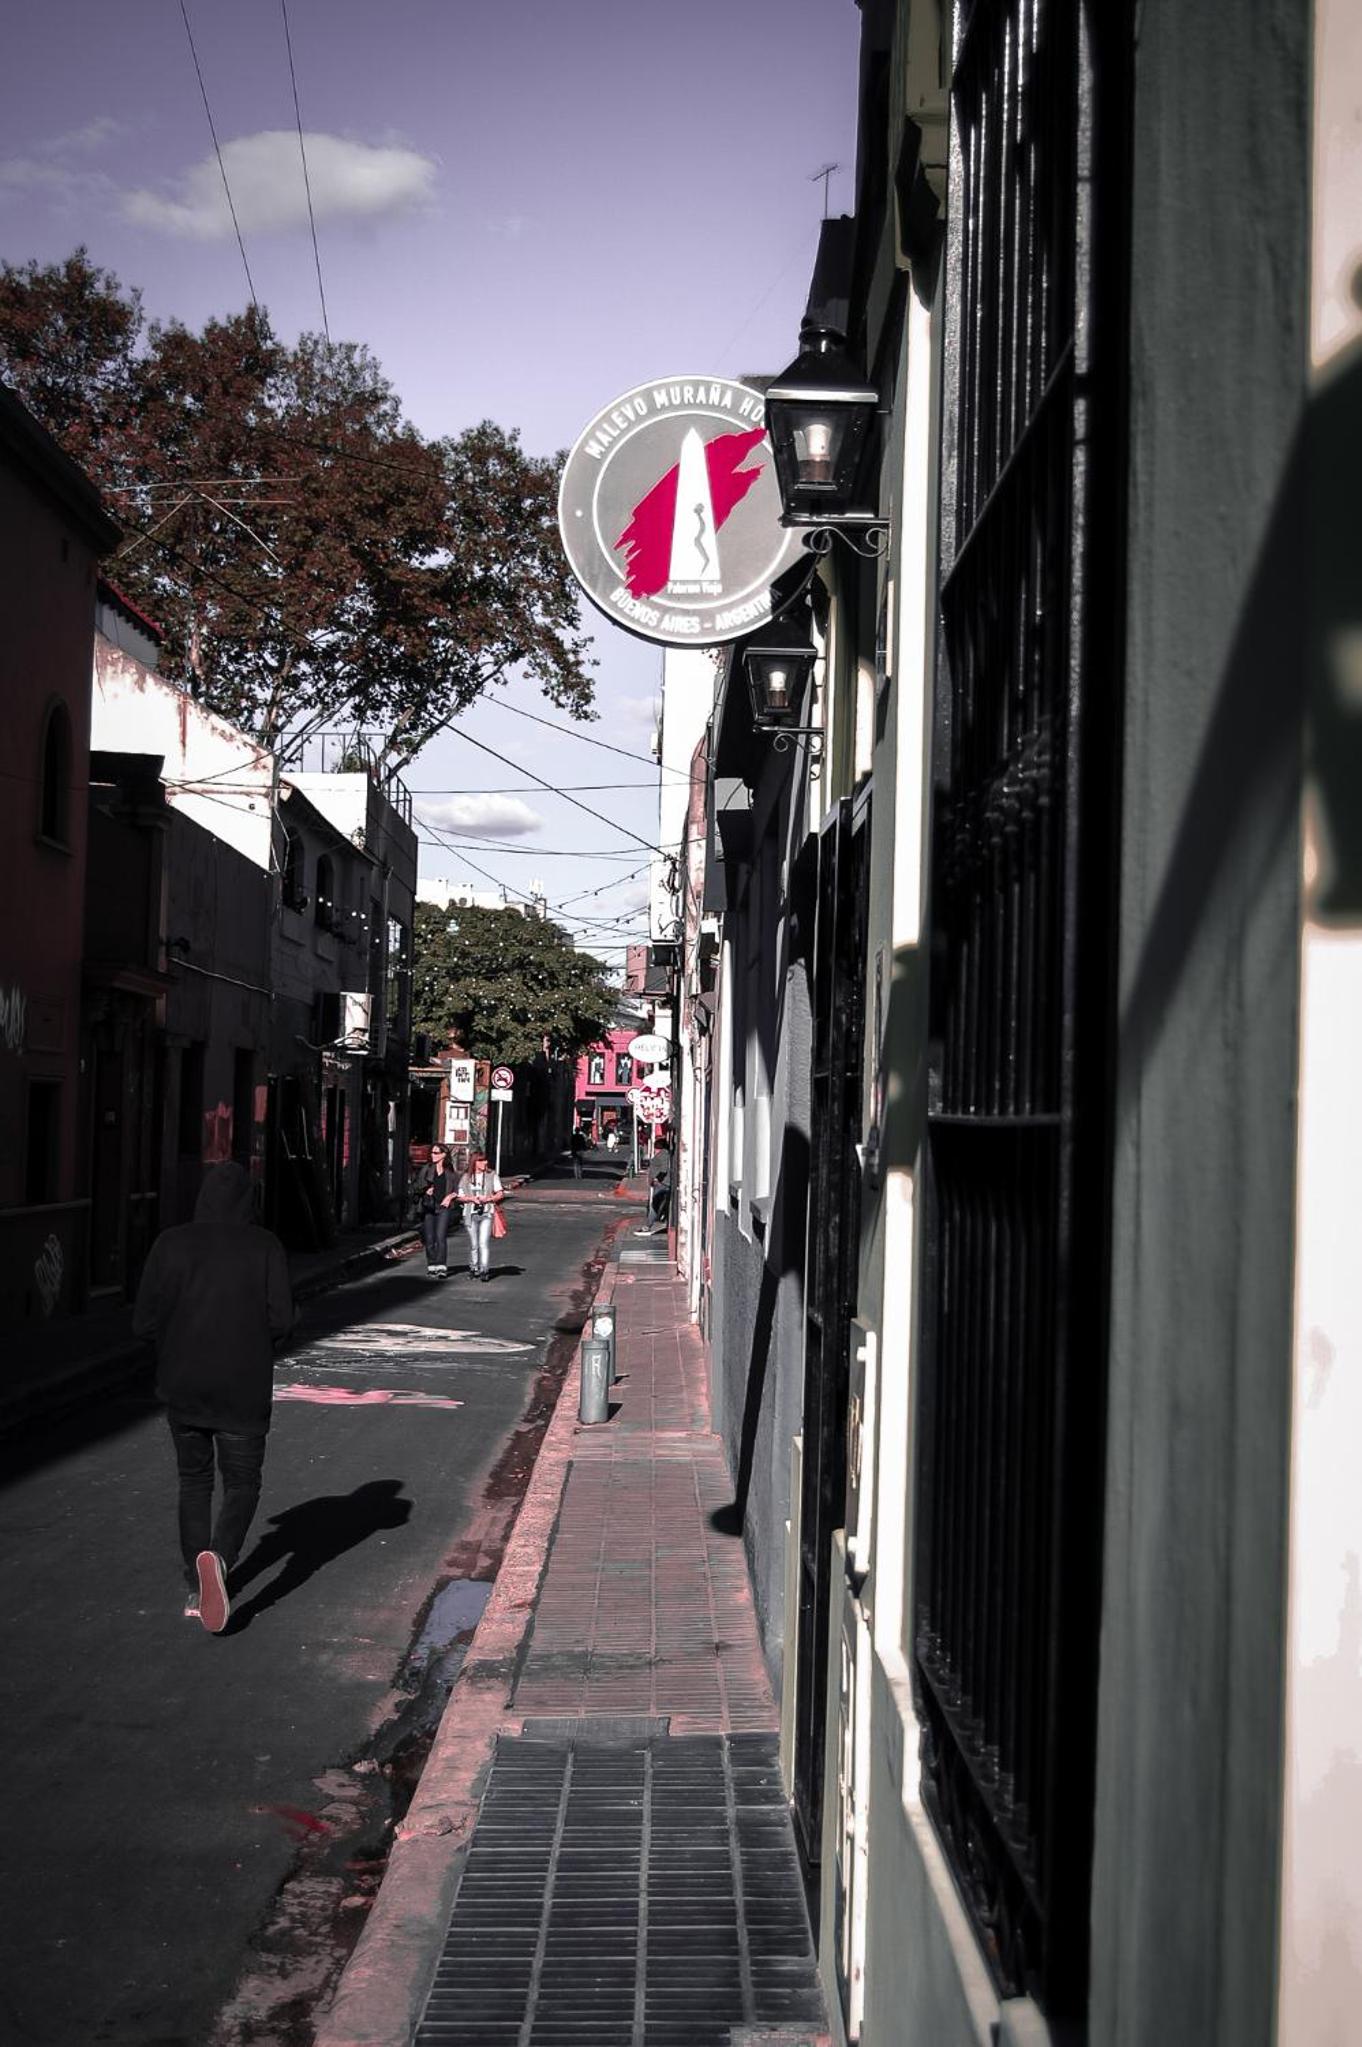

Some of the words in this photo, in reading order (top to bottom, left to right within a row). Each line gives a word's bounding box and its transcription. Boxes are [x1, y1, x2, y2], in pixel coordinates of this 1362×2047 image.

[584, 399, 650, 460] MALEVO
[653, 383, 732, 409] MURAÑA
[738, 398, 765, 428] HO
[609, 586, 660, 627] BUENOS
[661, 614, 701, 633] AIRES
